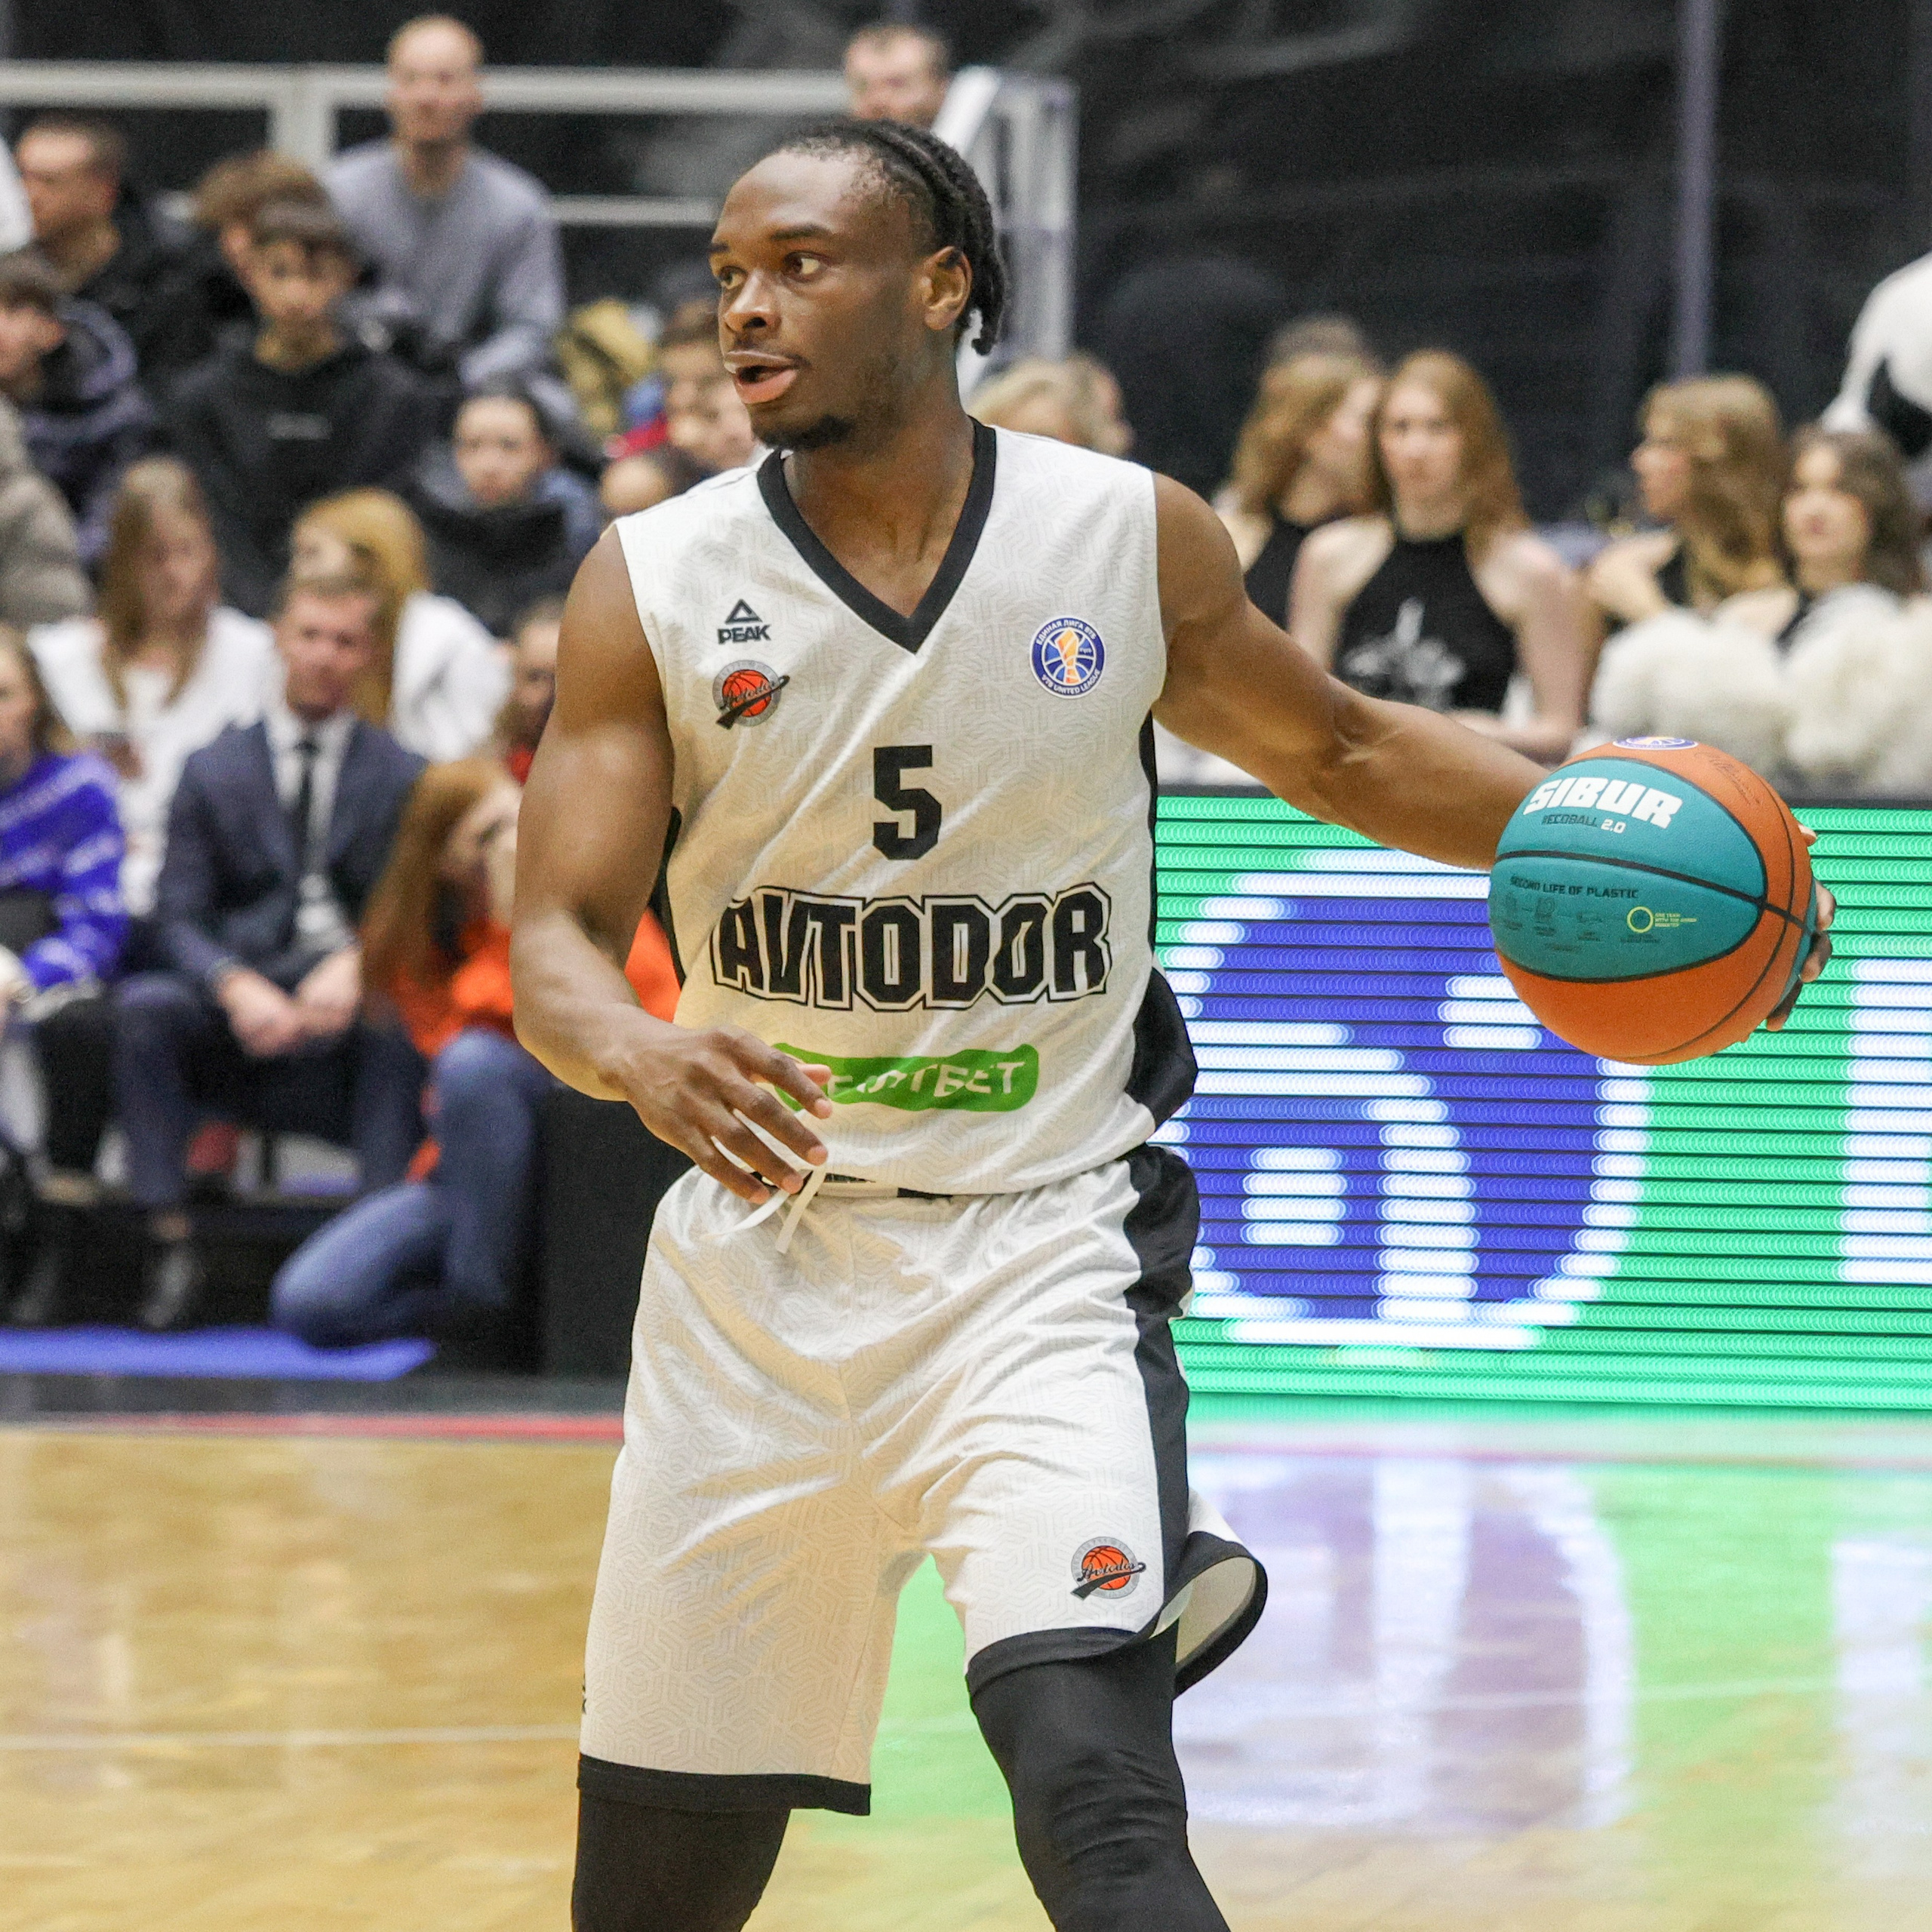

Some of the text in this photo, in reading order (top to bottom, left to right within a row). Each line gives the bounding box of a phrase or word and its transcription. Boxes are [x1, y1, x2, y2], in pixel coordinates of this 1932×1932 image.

[718, 624, 771, 644] PEAK
[1054, 685, 1081, 694] UNITED
[1080, 669, 1101, 691] LEAGUE
[872, 745, 942, 860] 5
[1523, 777, 1683, 829] SIBUR
[1601, 818, 1626, 833] 2.0
[1543, 883, 1565, 895] LIFE
[1568, 886, 1583, 895] OF
[1586, 887, 1639, 899] PLASTIC
[709, 881, 1112, 1012] AVTODOR
